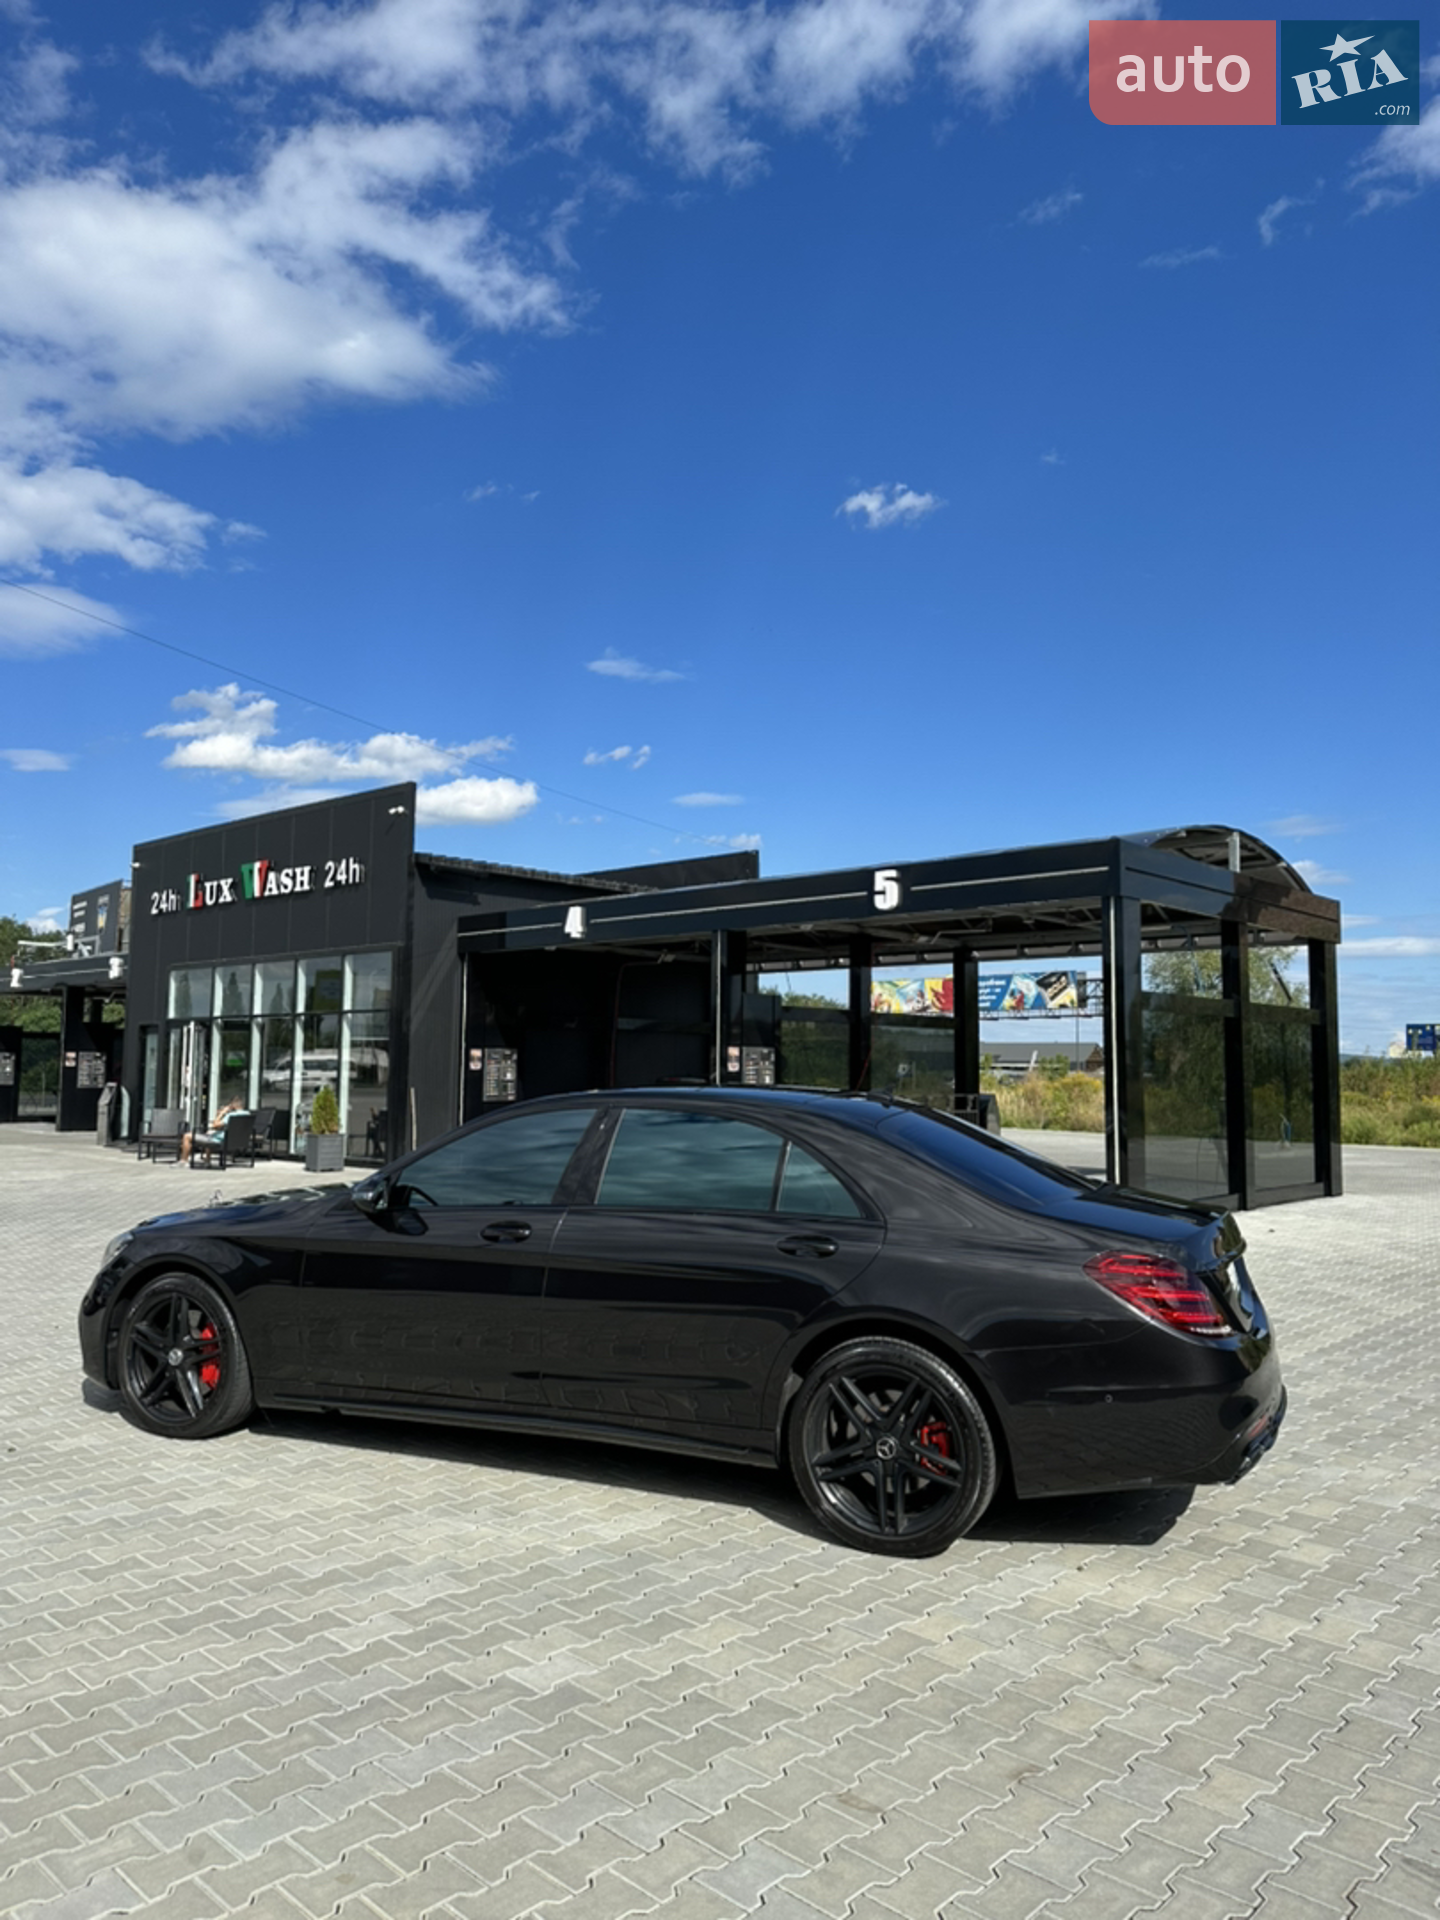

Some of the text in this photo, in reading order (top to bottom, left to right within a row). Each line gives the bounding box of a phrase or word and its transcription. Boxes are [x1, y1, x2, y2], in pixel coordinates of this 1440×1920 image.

[150, 857, 363, 915] 24h LUX WASH 24h
[873, 868, 901, 911] 5
[564, 905, 587, 939] 4
